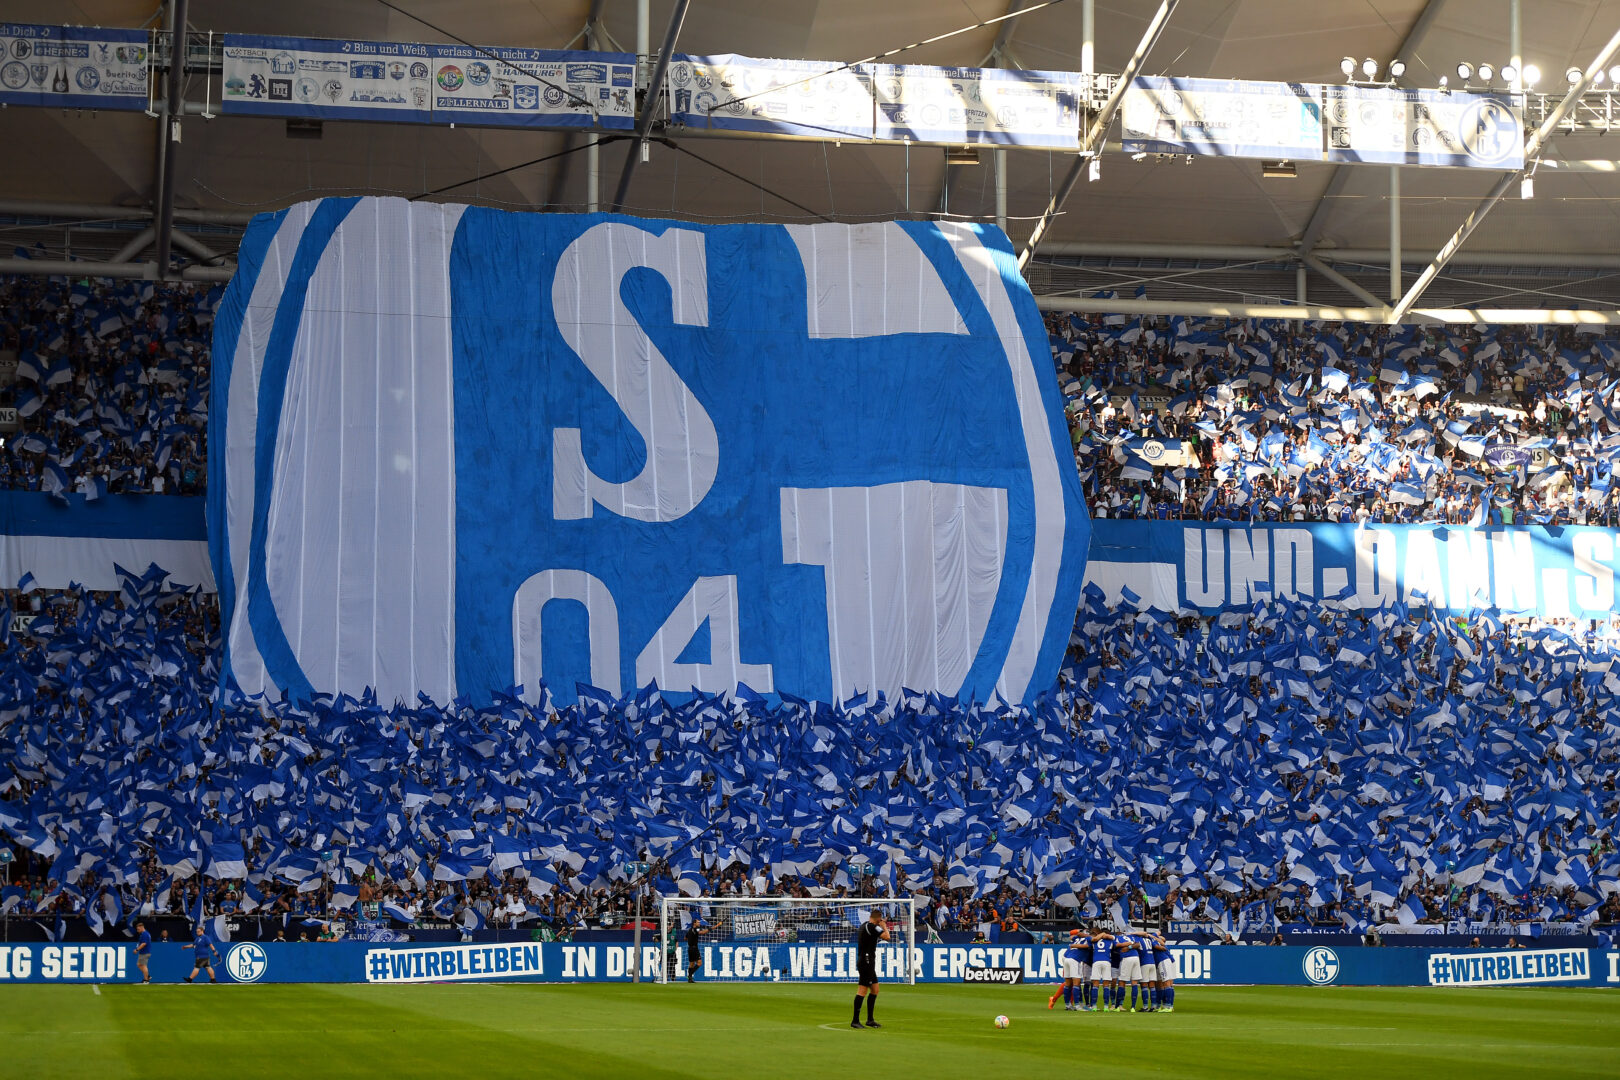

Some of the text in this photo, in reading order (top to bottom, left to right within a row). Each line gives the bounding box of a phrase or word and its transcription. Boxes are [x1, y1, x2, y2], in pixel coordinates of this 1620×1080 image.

[12, 26, 36, 37] Dich
[43, 48, 79, 57] HERNE
[354, 43, 376, 53] Blau
[380, 46, 398, 54] und
[437, 48, 527, 60] verlass mich nicht
[503, 68, 555, 77] HAMBURG
[735, 921, 767, 935] SIEGEN
[1097, 940, 1105, 949] 6
[41, 946, 126, 978] SEID!
[369, 945, 540, 980] #WIRBLEIBEN
[561, 946, 596, 977] IN
[704, 946, 781, 982] LIGA,
[1431, 951, 1586, 984] #WIRBLEIBEN
[964, 967, 1021, 984] betway
